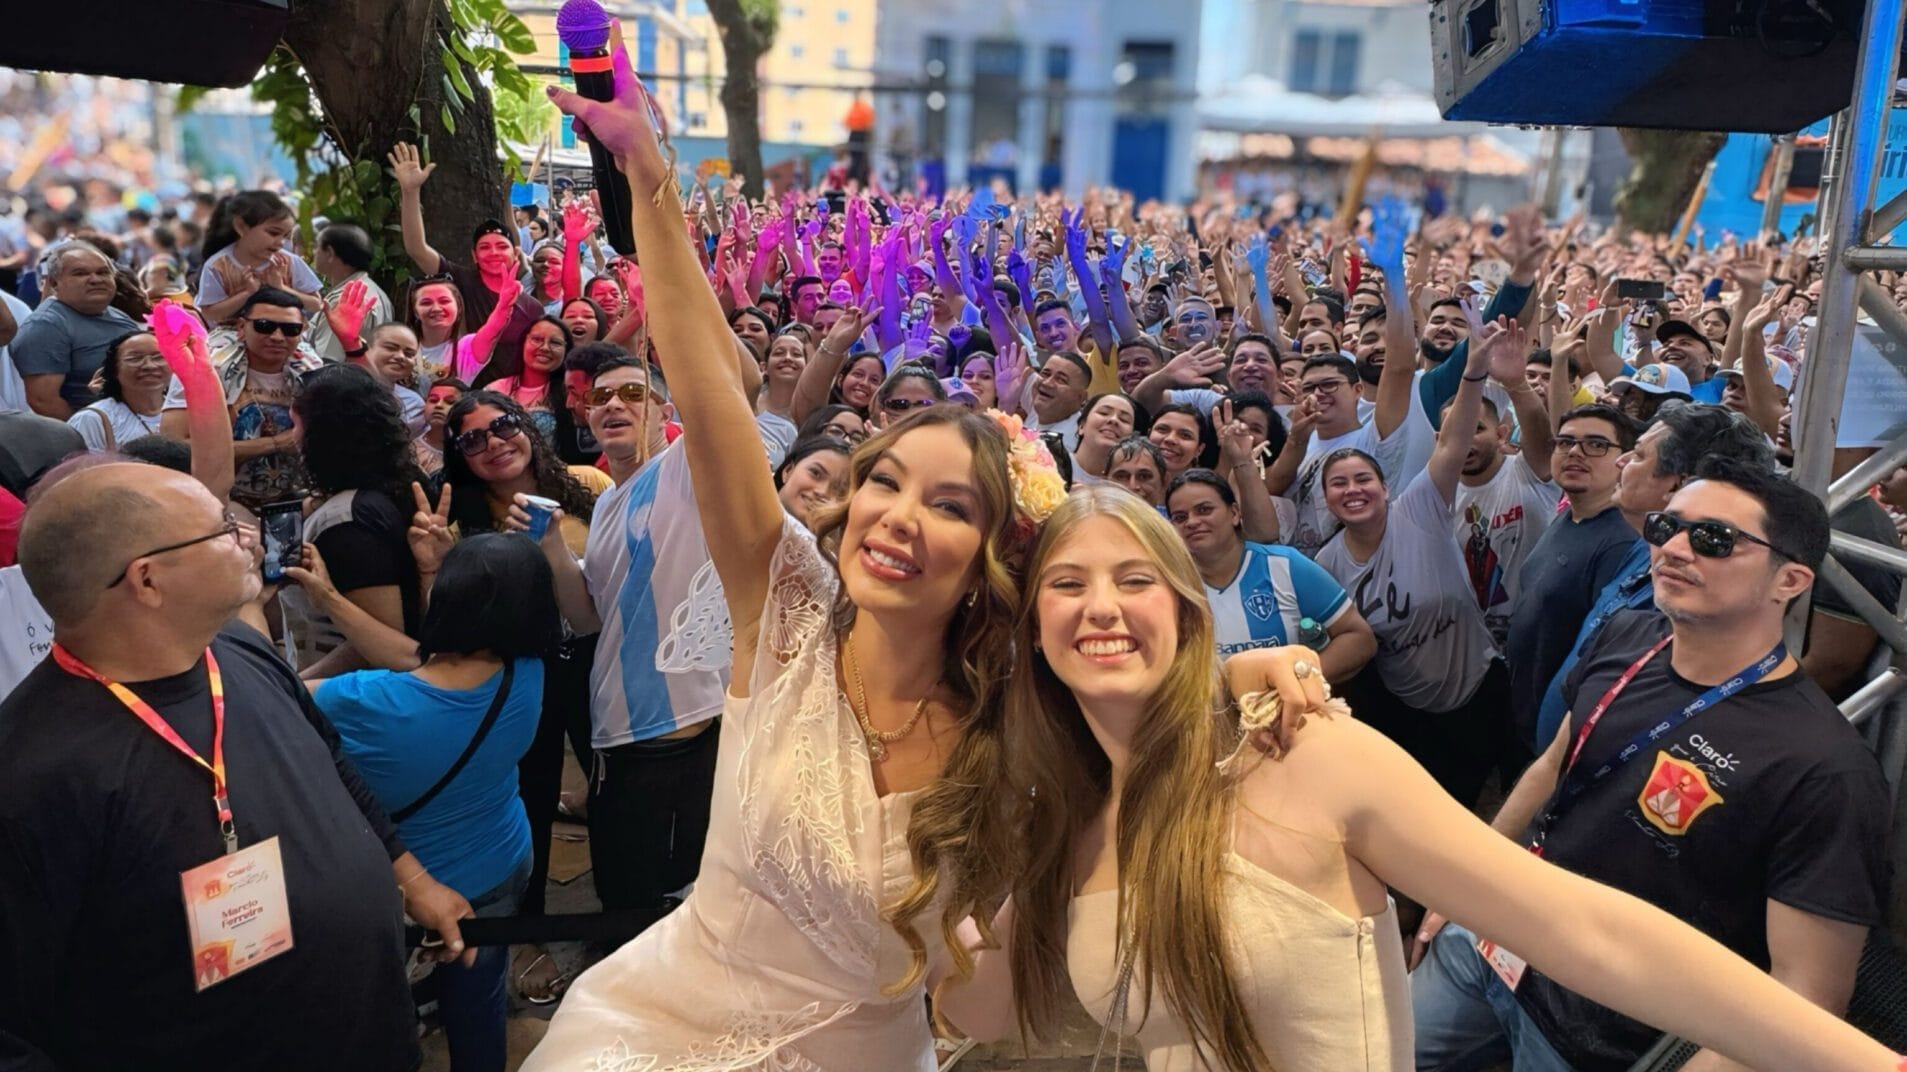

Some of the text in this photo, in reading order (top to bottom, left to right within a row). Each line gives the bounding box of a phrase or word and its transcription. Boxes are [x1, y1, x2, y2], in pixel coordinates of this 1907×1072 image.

[1721, 678, 1743, 694] Claro
[1684, 700, 1705, 716] Claro
[1689, 734, 1729, 768] Claro
